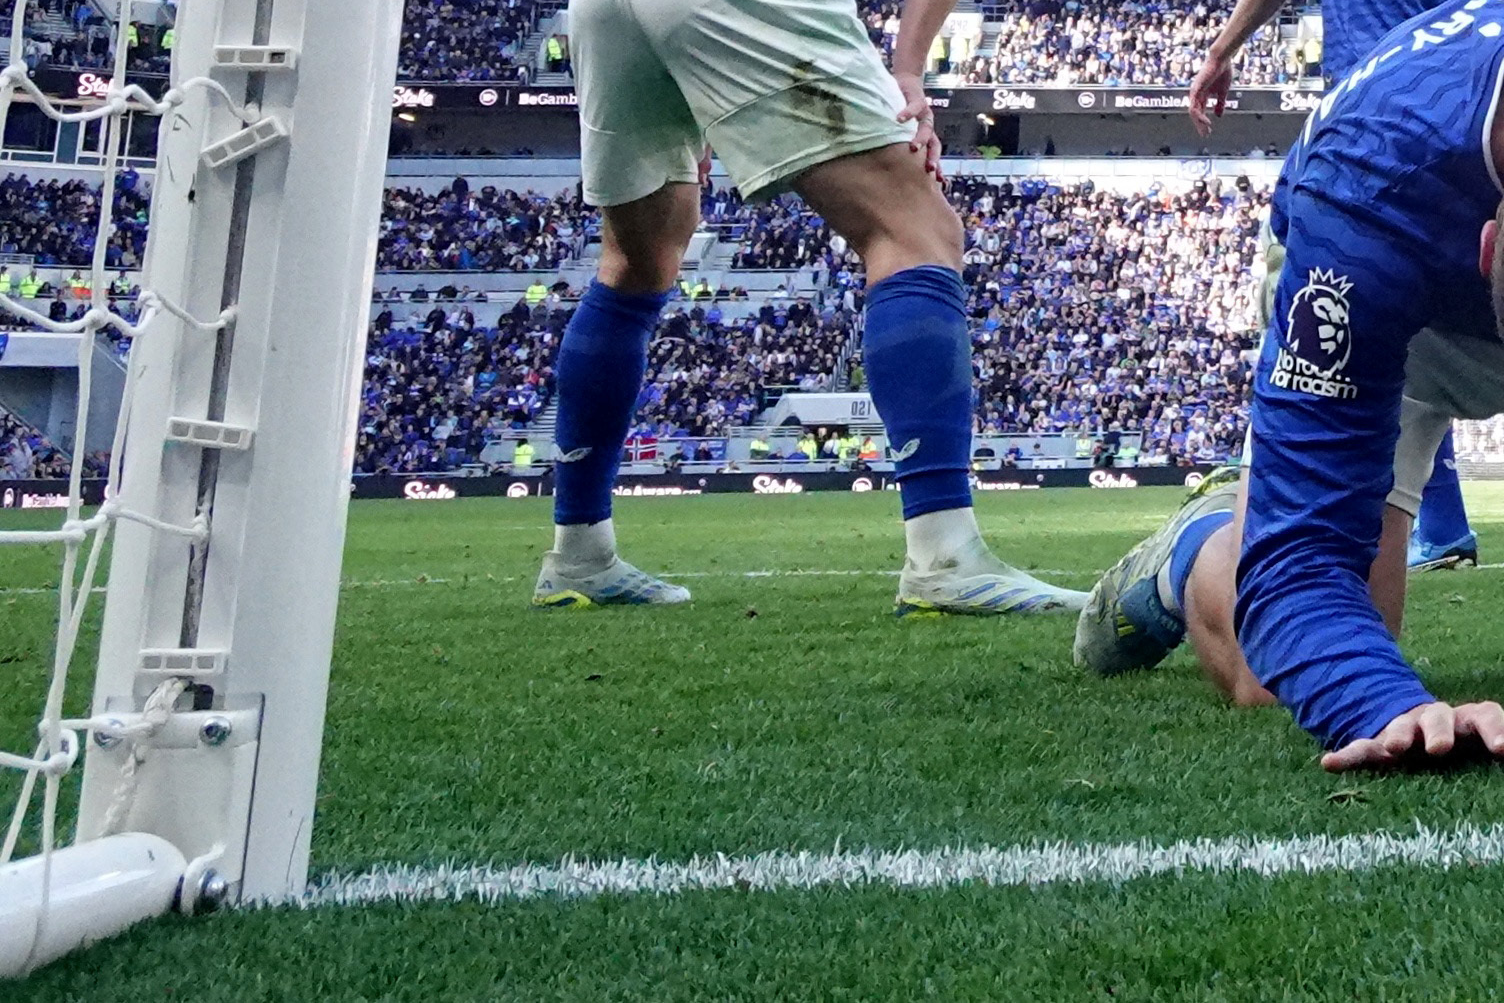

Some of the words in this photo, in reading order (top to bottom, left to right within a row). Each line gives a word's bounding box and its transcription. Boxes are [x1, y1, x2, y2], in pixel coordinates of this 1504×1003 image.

[993, 89, 1036, 110] Stake
[1292, 375, 1358, 399] racism
[851, 400, 871, 416] 021
